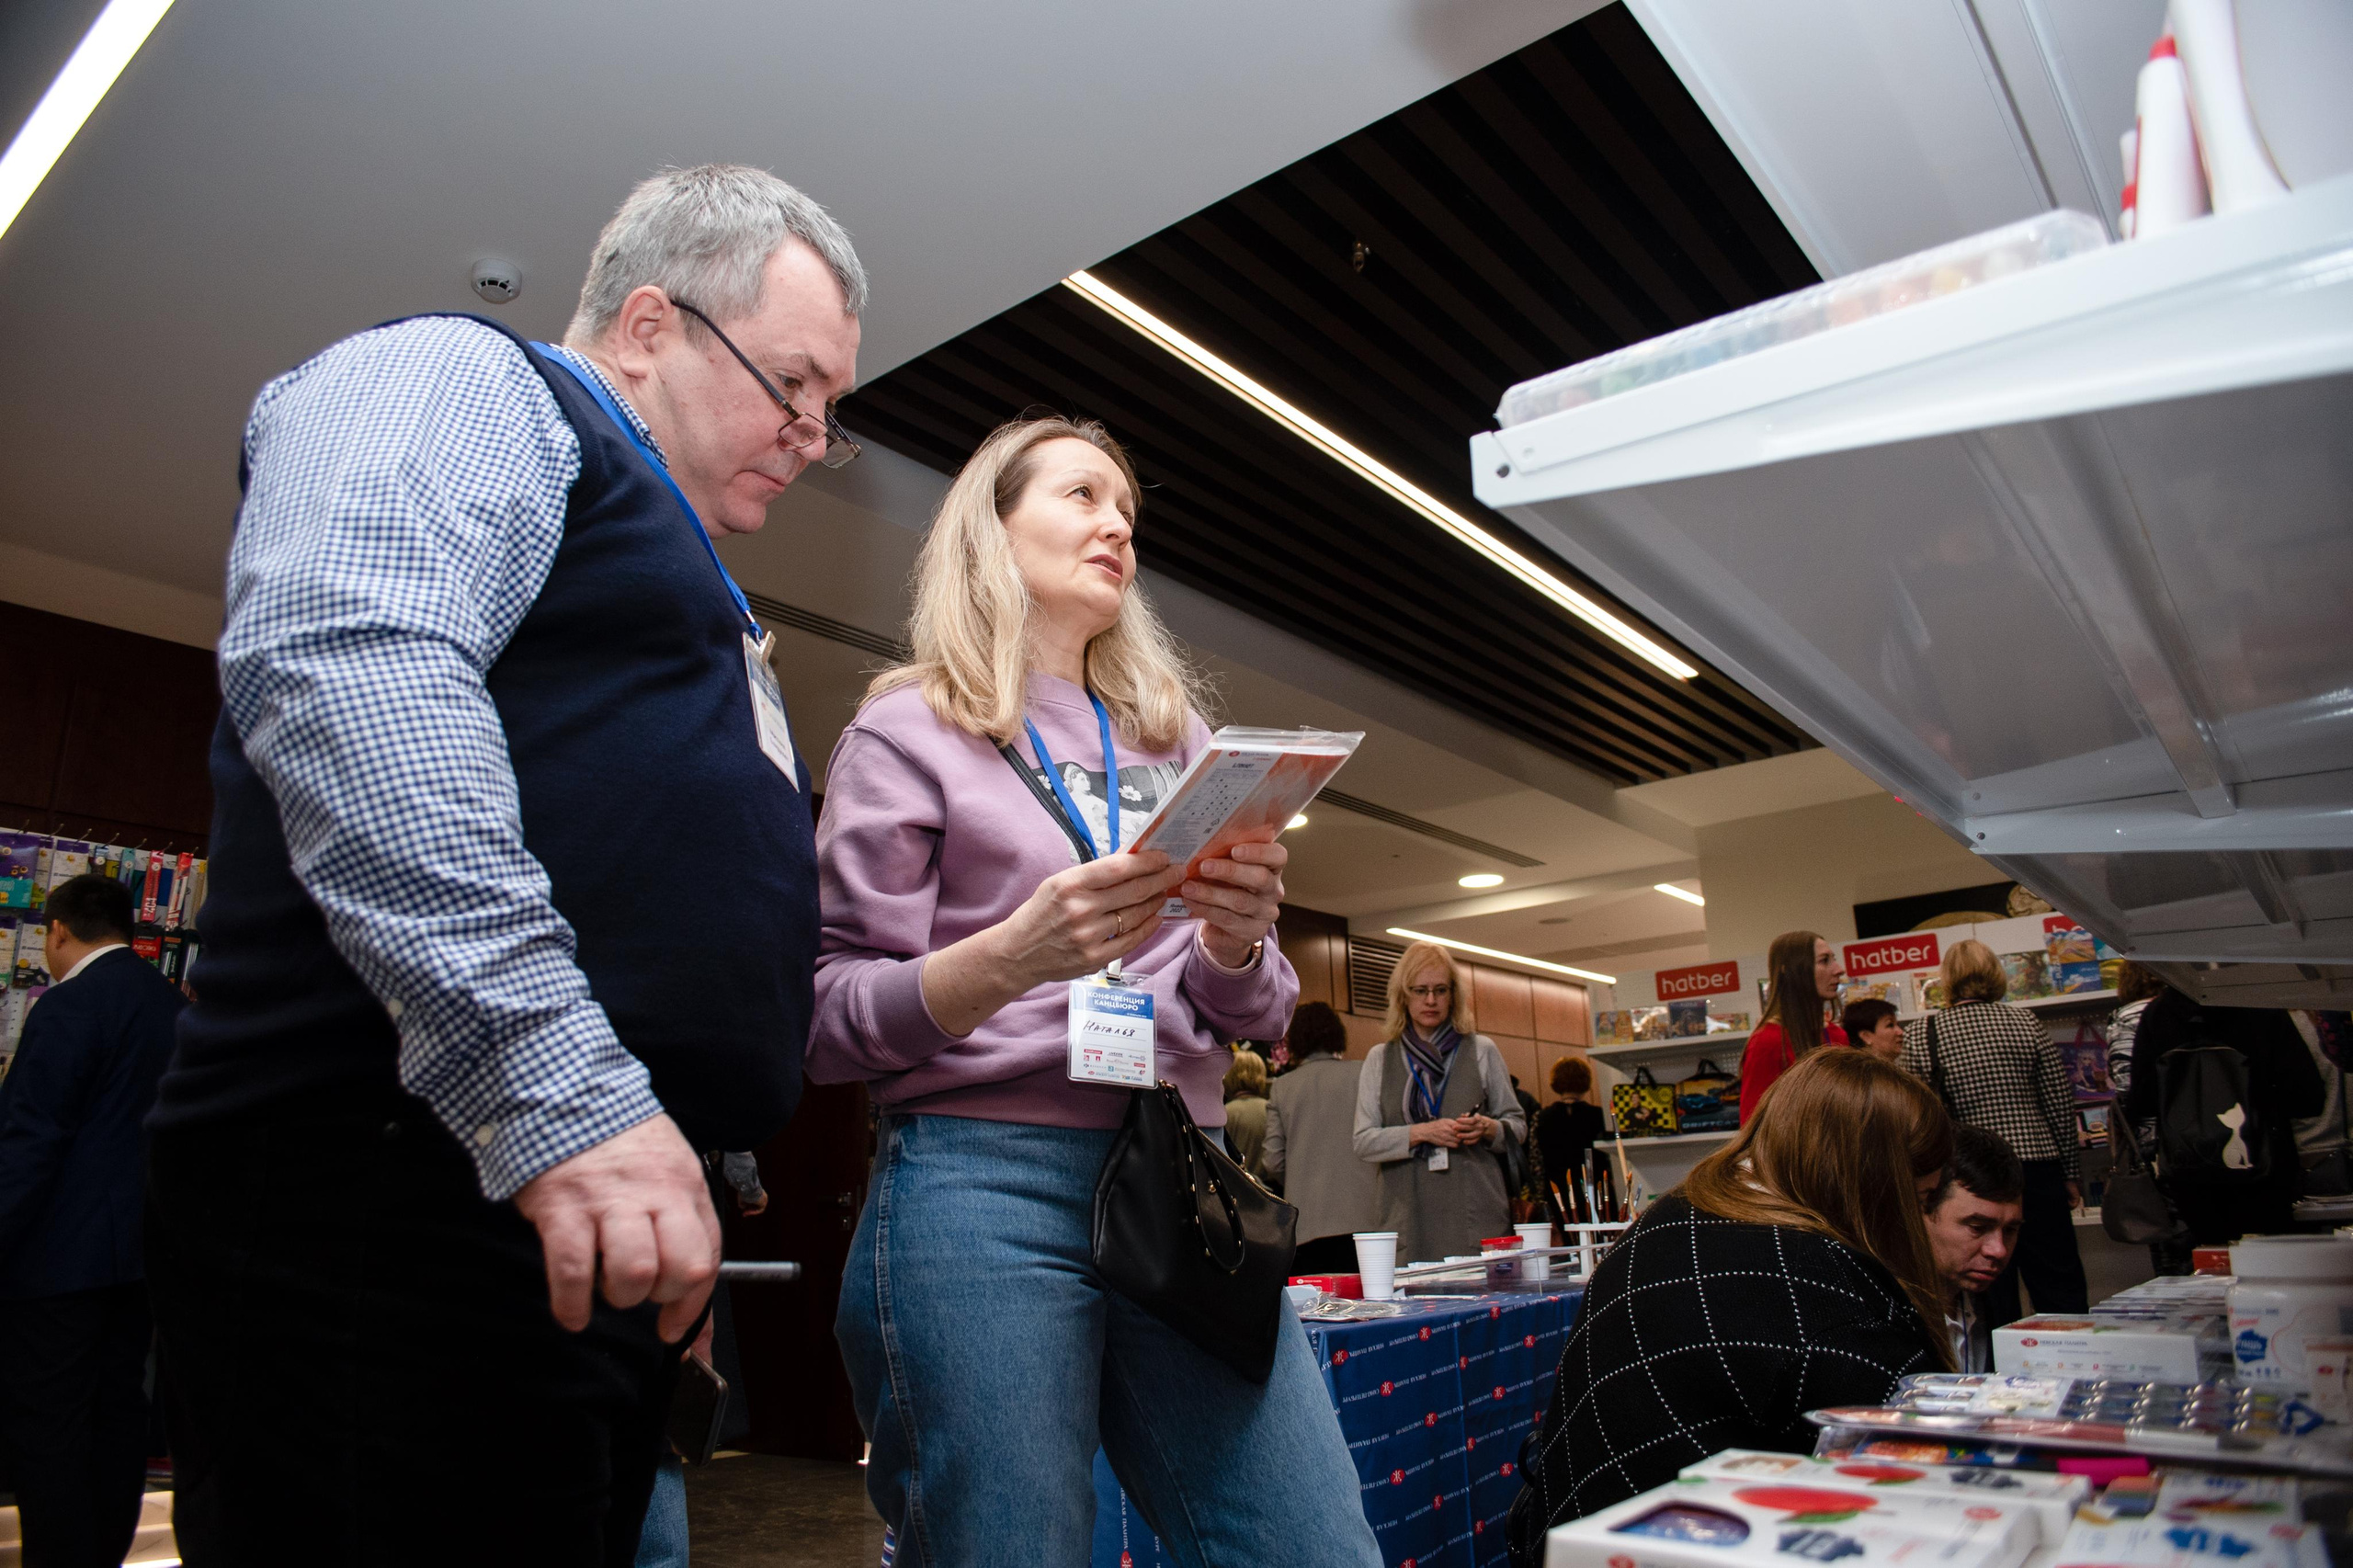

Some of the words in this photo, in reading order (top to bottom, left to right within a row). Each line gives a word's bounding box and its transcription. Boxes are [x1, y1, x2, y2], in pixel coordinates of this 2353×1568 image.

[1850, 944, 1931, 970] hatber
[1662, 971, 1733, 994] hatber
[1087, 991, 1145, 1006] КОНФЕРЕНЦИЯ
[1094, 999, 1139, 1011] КАНЦБЮРО
